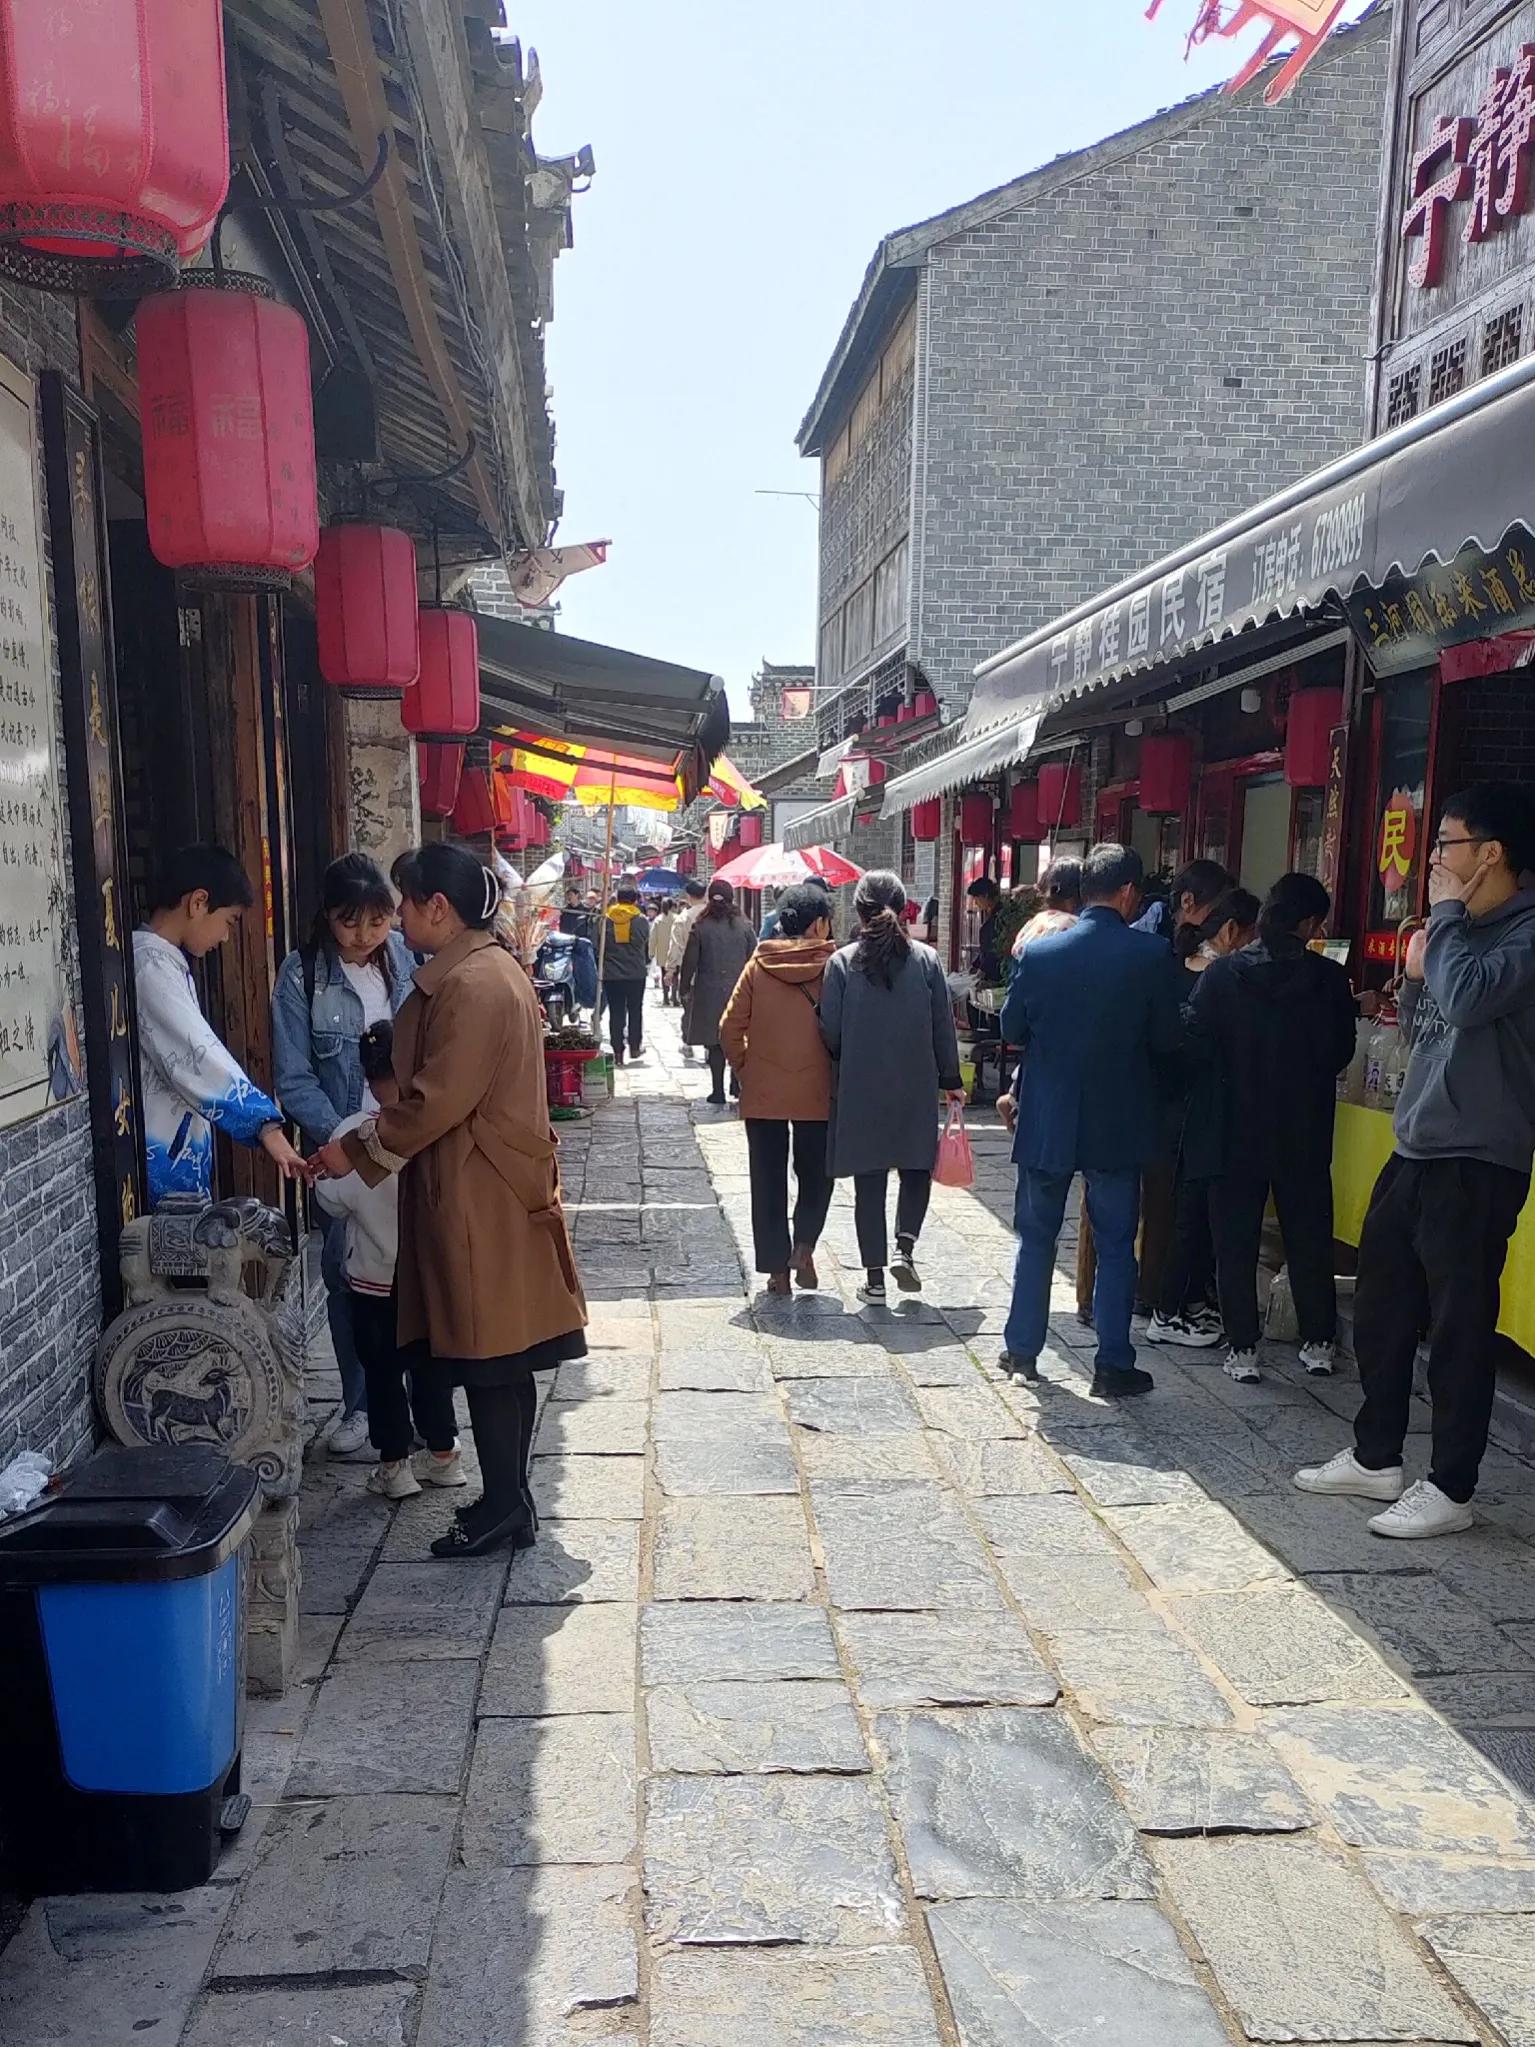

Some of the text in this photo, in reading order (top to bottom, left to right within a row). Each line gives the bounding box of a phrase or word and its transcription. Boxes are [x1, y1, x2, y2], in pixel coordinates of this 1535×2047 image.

[1051, 552, 1227, 692] 宁静桂园民宿
[1379, 810, 1407, 876] 民
